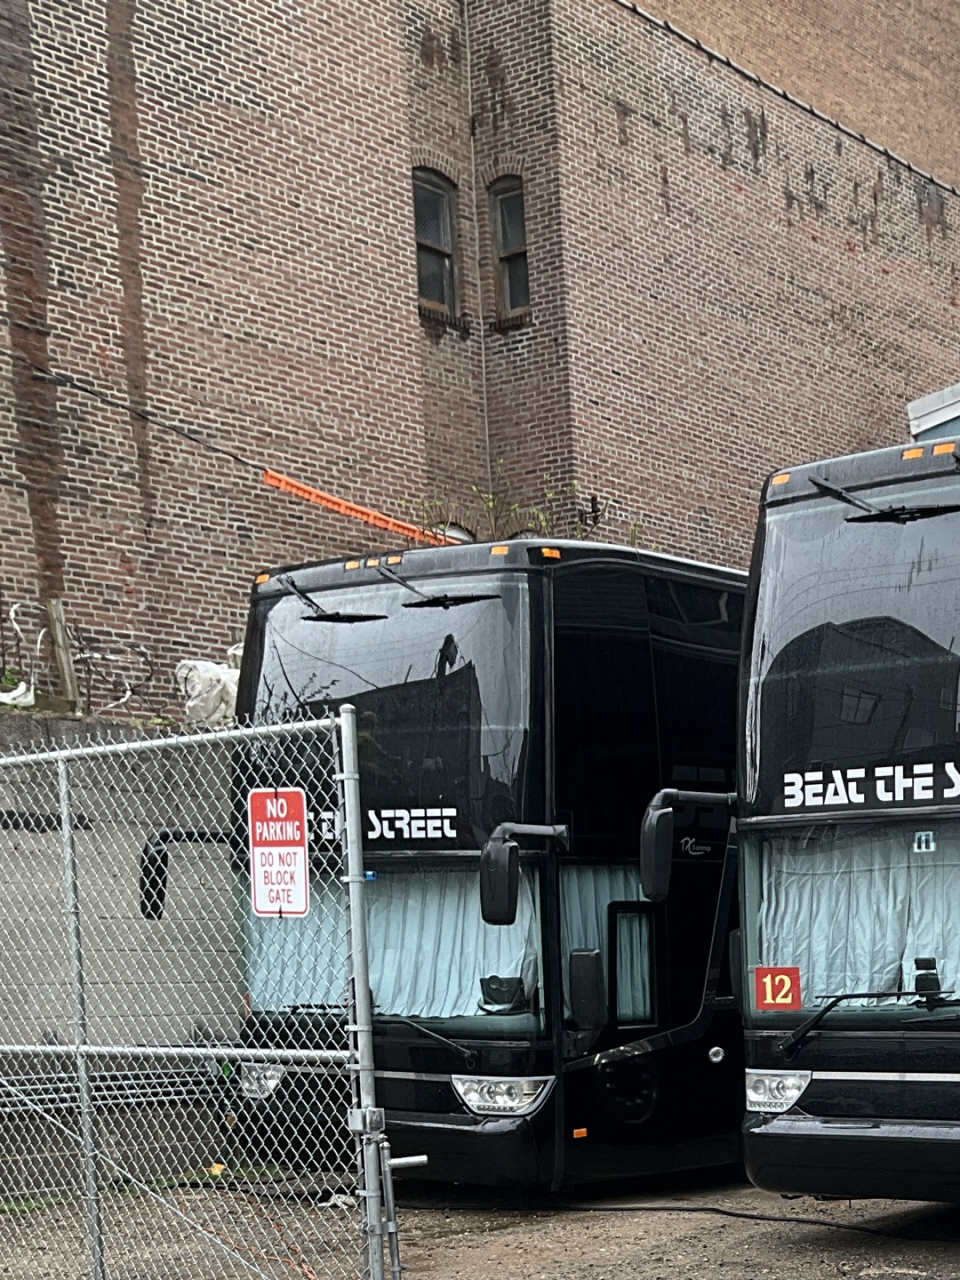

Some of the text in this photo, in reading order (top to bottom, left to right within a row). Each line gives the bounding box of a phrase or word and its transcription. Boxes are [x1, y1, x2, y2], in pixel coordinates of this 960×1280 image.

[784, 767, 866, 808] BEAT
[874, 763, 934, 801] THE
[266, 798, 288, 818] NO
[255, 820, 301, 841] PARKING
[367, 808, 457, 840] STREET
[260, 851, 298, 867] DO NOT
[263, 870, 296, 886] BLOCK
[268, 888, 293, 904] GATE
[762, 973, 793, 1004] 12
